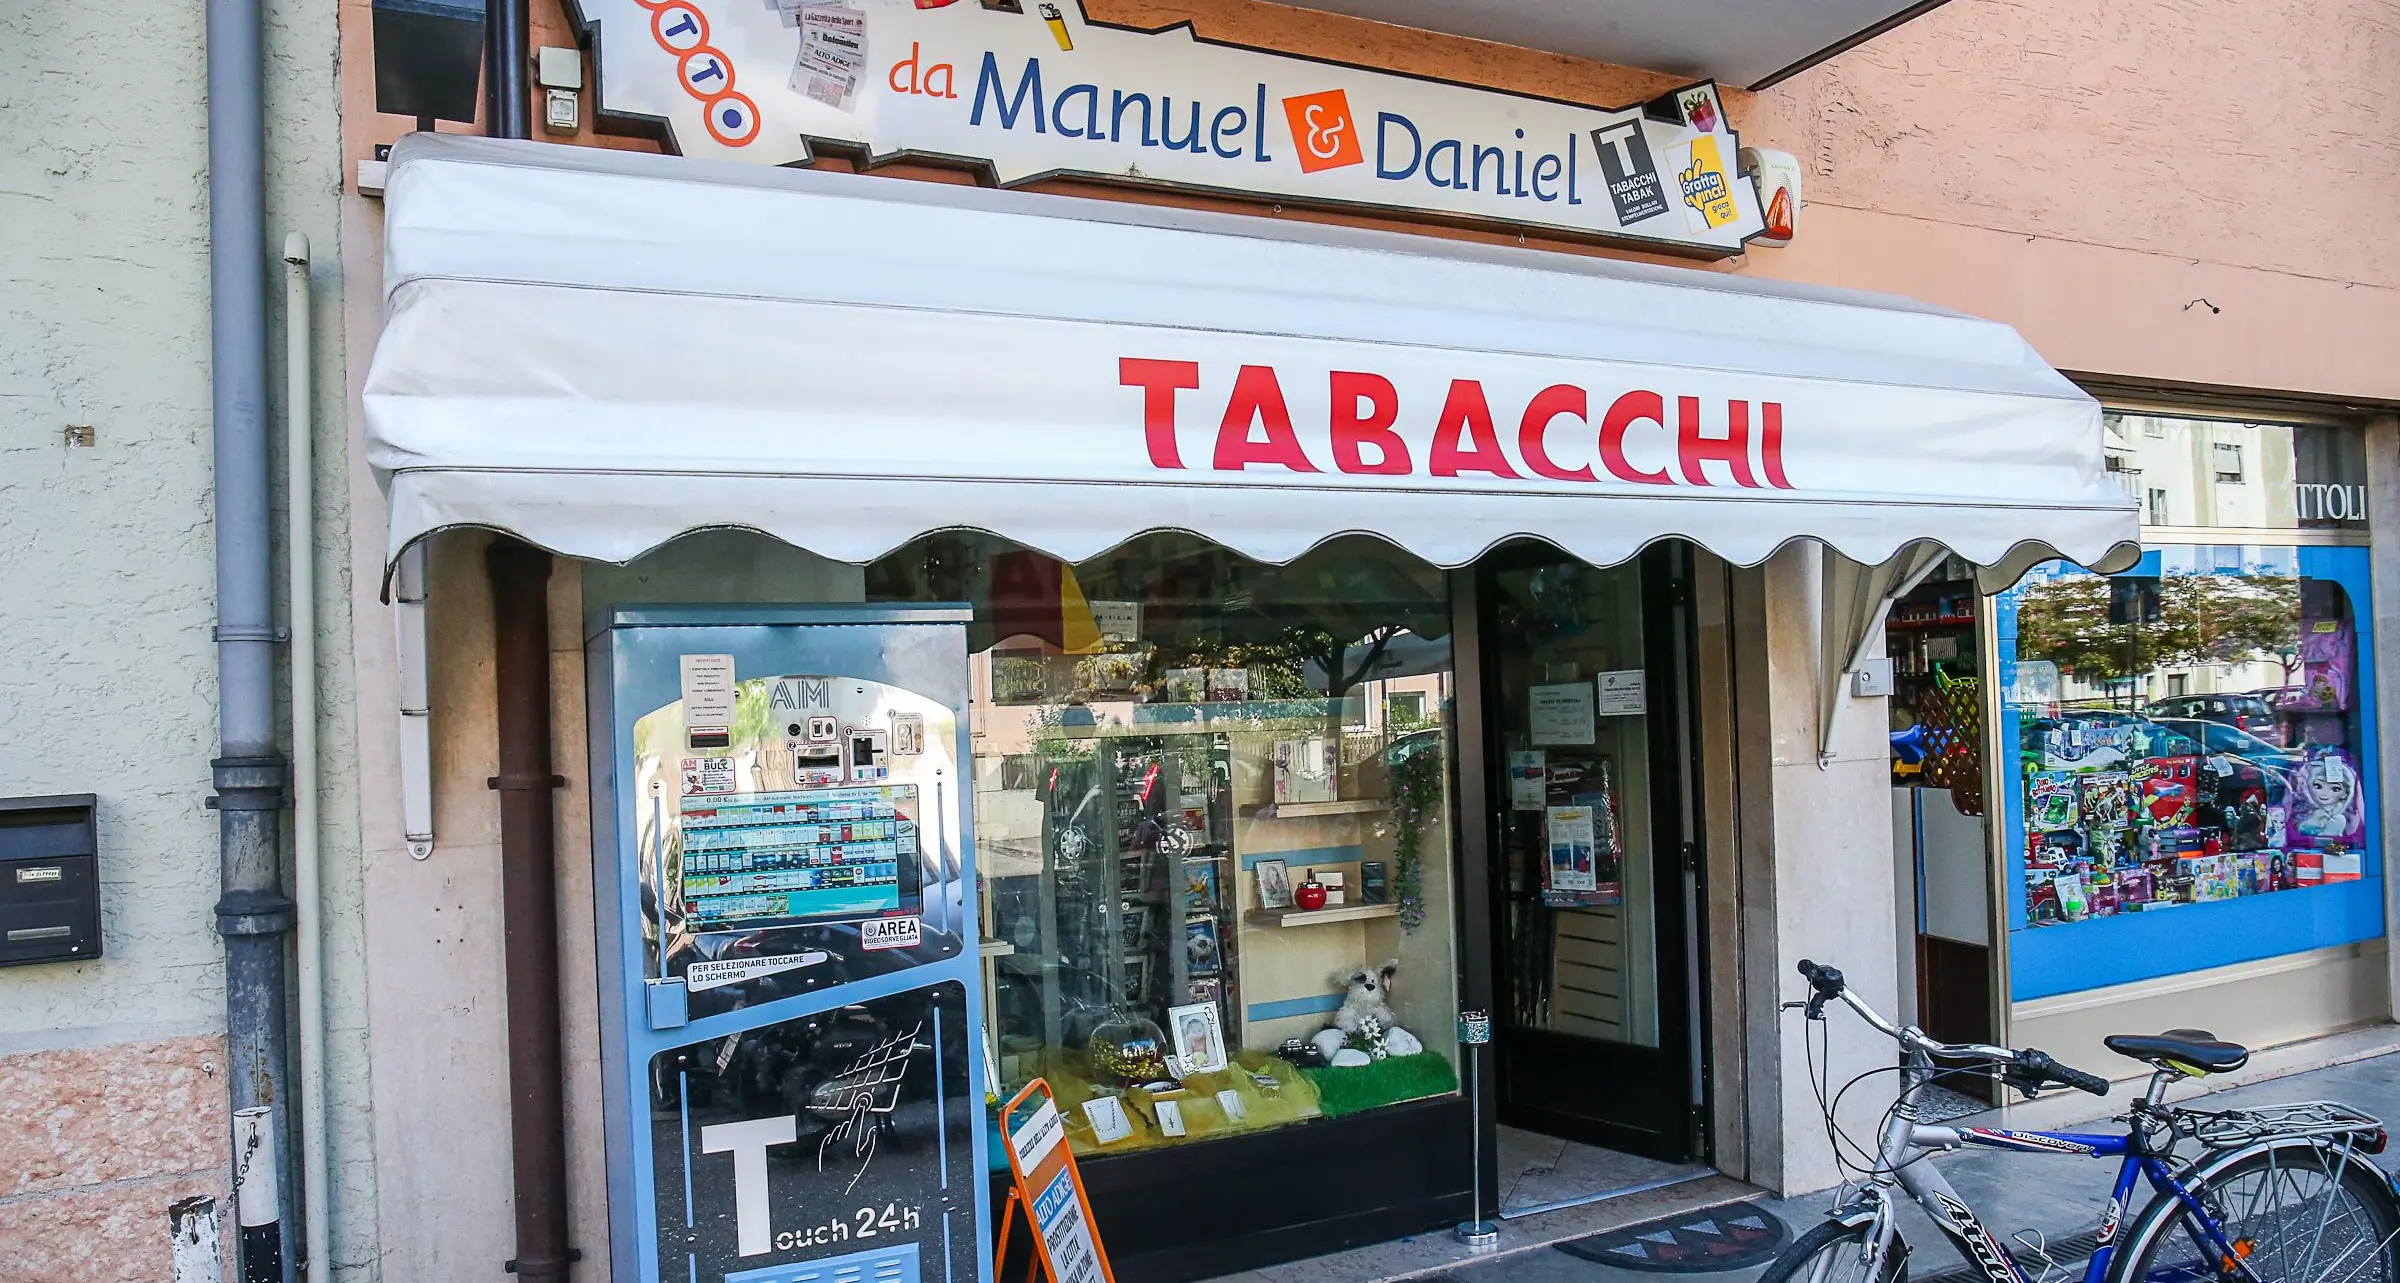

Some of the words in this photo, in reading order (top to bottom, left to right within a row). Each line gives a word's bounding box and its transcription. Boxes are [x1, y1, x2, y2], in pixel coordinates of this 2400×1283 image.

[814, 49, 831, 60] ALTO
[889, 42, 958, 99] da
[970, 50, 1272, 163] Manuel
[1304, 103, 1345, 160] &
[1376, 111, 1582, 206] Daniel
[1599, 124, 1636, 177] T
[1610, 171, 1657, 195] TABACCHI
[1682, 174, 1718, 195] Gratta
[1620, 185, 1655, 205] TABAK
[1711, 201, 1729, 214] gioca
[1118, 357, 1798, 490] TABACCHI
[769, 680, 830, 710] AM
[877, 919, 917, 937] AREA
[863, 933, 918, 945] VIDEOSORVEGLIATA
[692, 965, 709, 973] PER
[710, 957, 767, 971] SELEZIONARE
[768, 955, 805, 966] TOCCARE
[692, 974, 704, 983] LO
[705, 970, 746, 981] SCHERMO
[1035, 1195, 1054, 1226] ALTO
[1051, 1173, 1073, 1209] ADIGE
[855, 1202, 921, 1239] 24h
